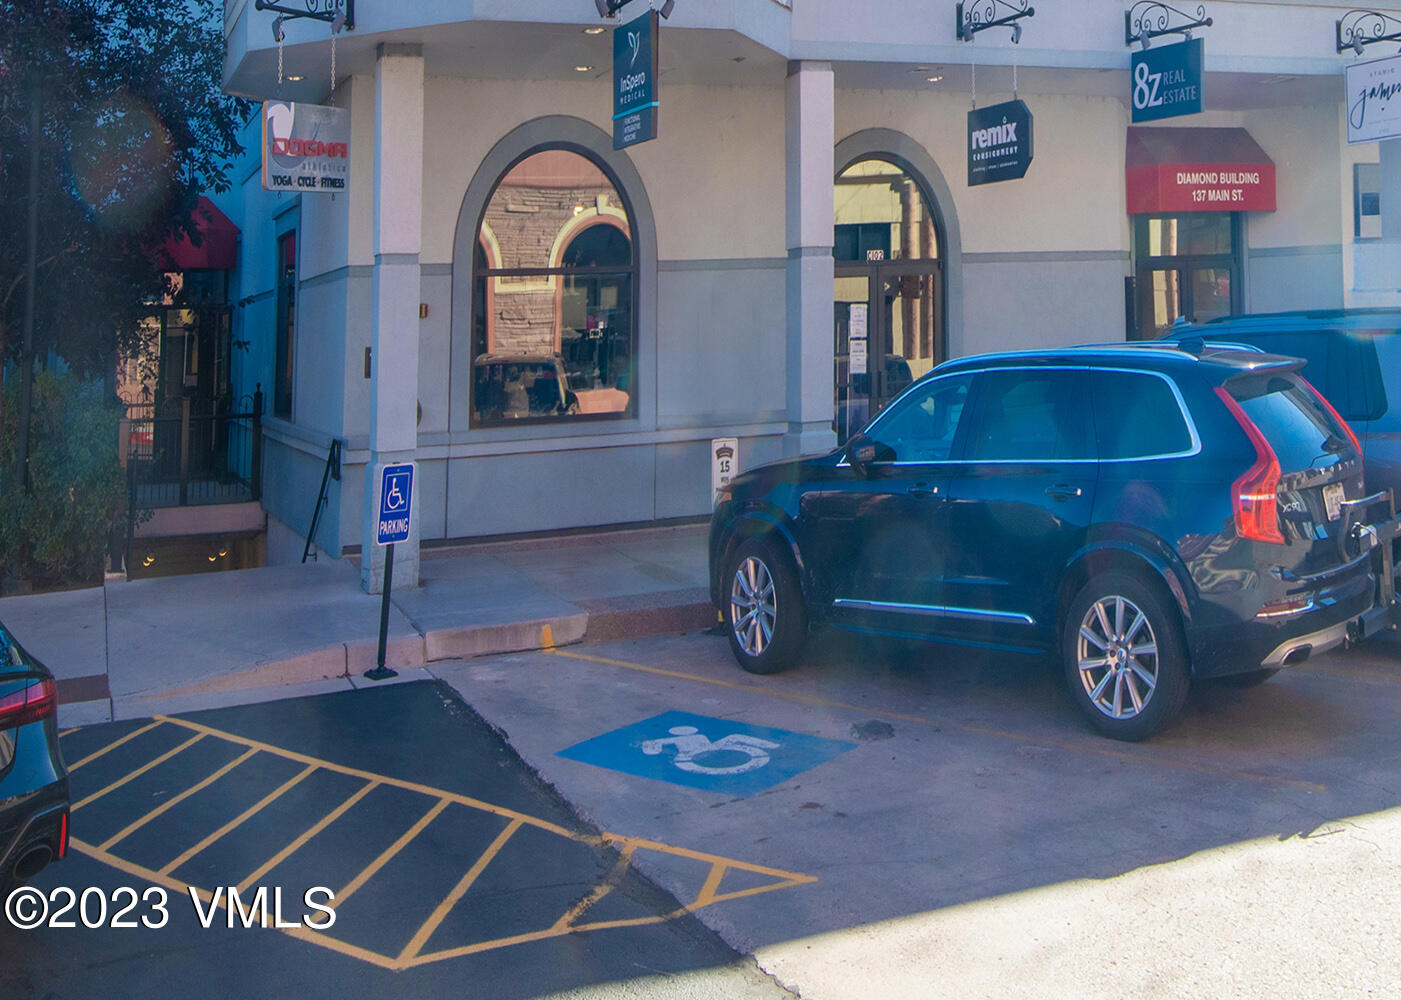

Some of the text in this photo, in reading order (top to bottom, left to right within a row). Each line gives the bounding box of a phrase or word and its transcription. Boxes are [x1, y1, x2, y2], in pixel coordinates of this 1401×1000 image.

[620, 71, 646, 94] InSpero
[1163, 69, 1186, 85] REAL
[620, 92, 646, 105] MEDICAL
[1163, 85, 1197, 105] ESTATE
[972, 116, 1017, 150] remix
[272, 138, 348, 158] DOGMA
[973, 146, 1018, 161] CONSIGNMENT
[272, 175, 344, 188] YOGA CYCLE FITNESS
[1177, 172, 1259, 184] DIAMOND BUILDING
[1192, 189, 1244, 201] 137 MAIN ST.
[720, 460, 730, 472] 15
[1282, 501, 1301, 513] XC90
[380, 518, 408, 535] PARKING
